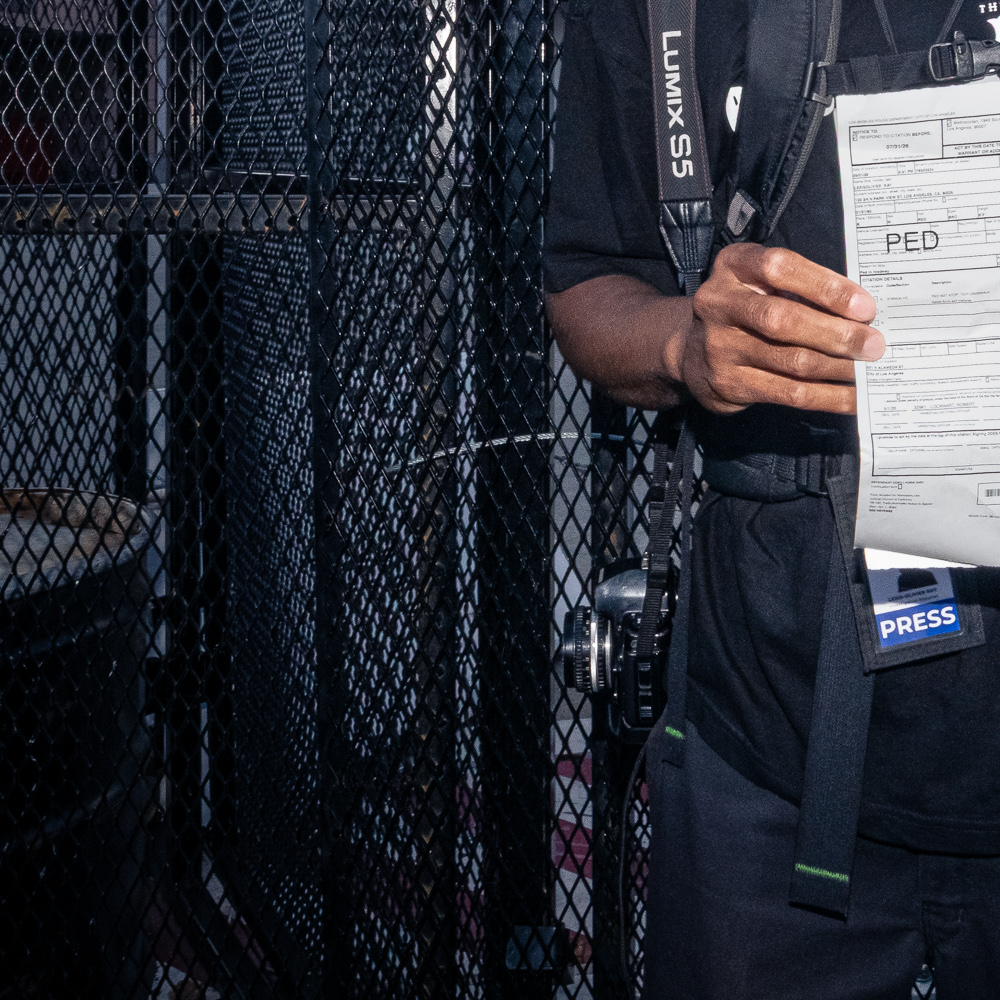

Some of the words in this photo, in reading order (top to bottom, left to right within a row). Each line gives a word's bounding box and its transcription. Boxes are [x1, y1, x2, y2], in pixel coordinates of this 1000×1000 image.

[661, 30, 685, 129] LUMIX
[669, 133, 694, 179] S5
[886, 230, 939, 253] PED
[879, 606, 956, 639] PRESS
